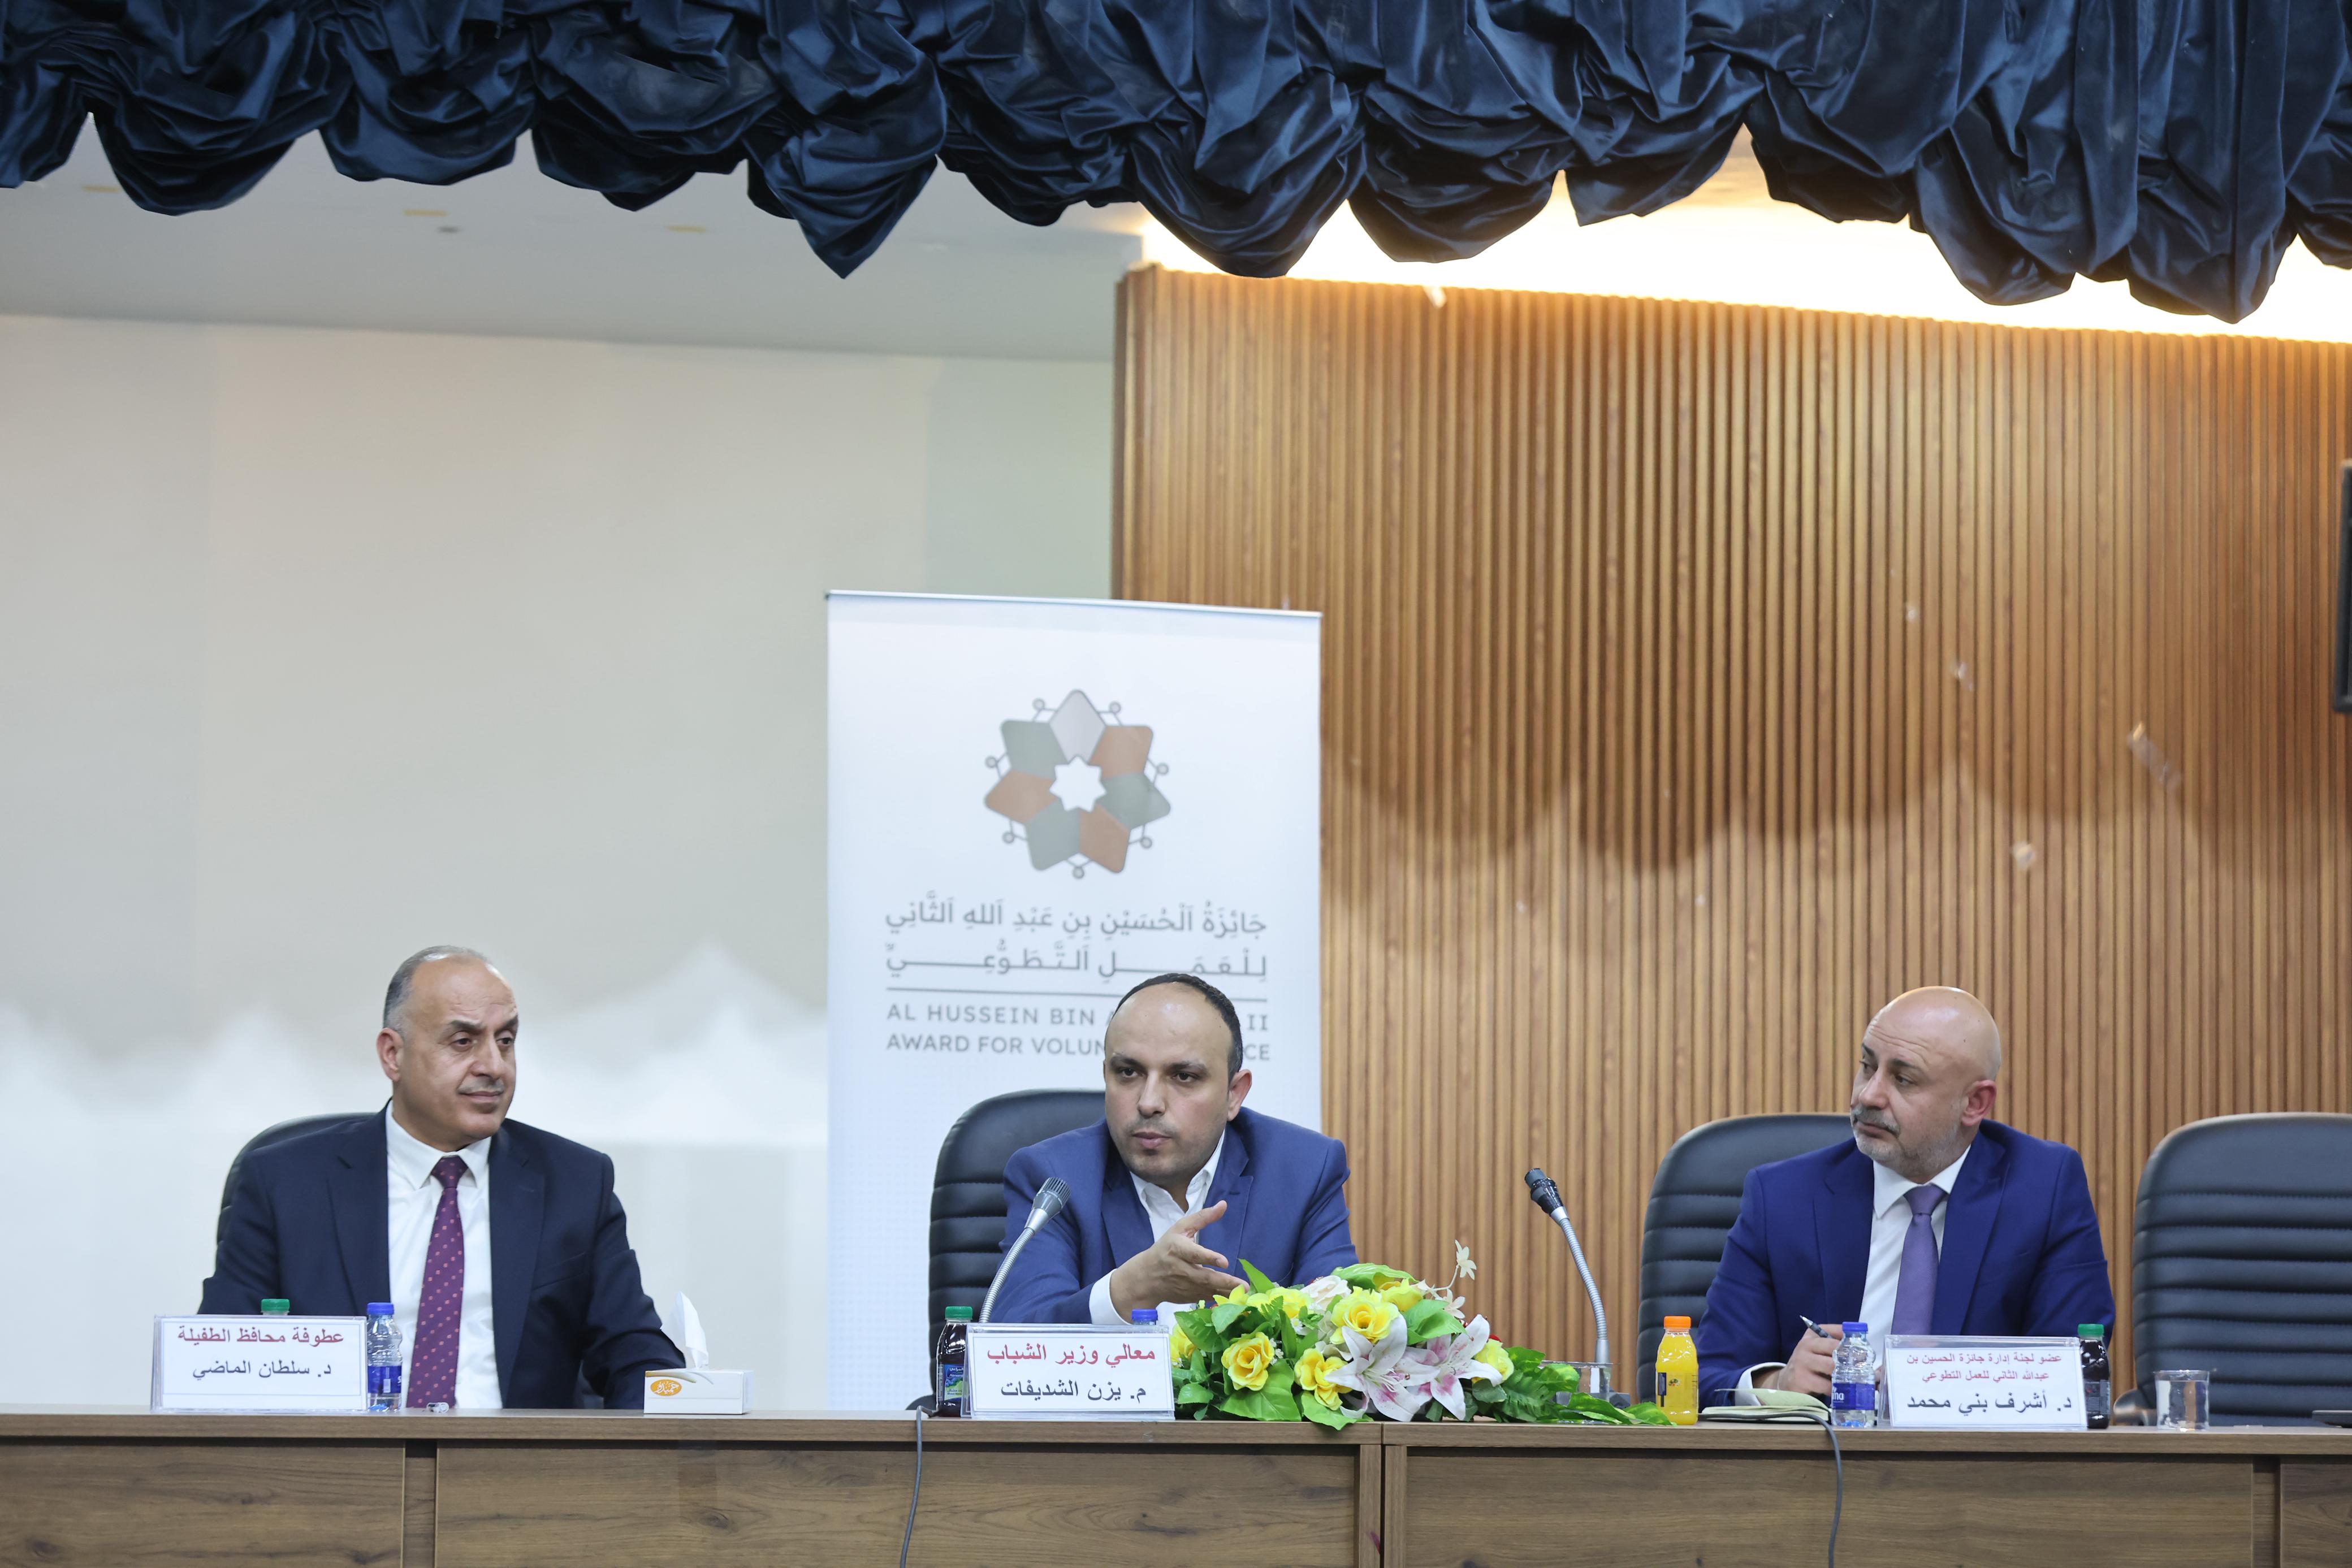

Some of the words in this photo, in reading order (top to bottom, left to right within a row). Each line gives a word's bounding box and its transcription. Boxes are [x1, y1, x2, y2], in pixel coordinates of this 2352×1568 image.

[887, 1004, 915, 1021] AL
[928, 1006, 1038, 1024] HUSSEIN
[1050, 1008, 1094, 1025] BIN
[1247, 1013, 1268, 1031] II
[887, 1034, 969, 1051] AWARD
[979, 1037, 1022, 1053] FOR
[178, 1325, 231, 1346] الطفيلة
[236, 1327, 286, 1343] محافظ
[292, 1327, 344, 1348] عطوفة
[987, 1342, 1047, 1365] الشباب
[1055, 1345, 1099, 1365] وزير
[1105, 1343, 1156, 1368] معالي
[1907, 1354, 1918, 1364] بن
[1922, 1353, 1955, 1364] الحسين
[1959, 1353, 1985, 1364] جائزة
[1988, 1354, 2009, 1365] إدارة
[2013, 1352, 2034, 1364] لجنة
[2039, 1354, 2062, 1364] عضو
[192, 1359, 251, 1381] الماضي
[258, 1359, 310, 1379] سلطان
[318, 1364, 332, 1378] د.
[1922, 1370, 1961, 1383] التطوعي
[1965, 1370, 1990, 1381] للعمل
[1992, 1370, 2018, 1383] الثاني
[2022, 1370, 2050, 1381] عبدالله
[1001, 1379, 1079, 1401] الشديفات
[1087, 1381, 1122, 1401] يزن
[1131, 1388, 1146, 1404] م.
[1907, 1396, 1951, 1408] محمد
[1958, 1393, 1988, 1417] بني
[1995, 1390, 2047, 1414] أشرف
[2057, 1396, 2072, 1411] د.
